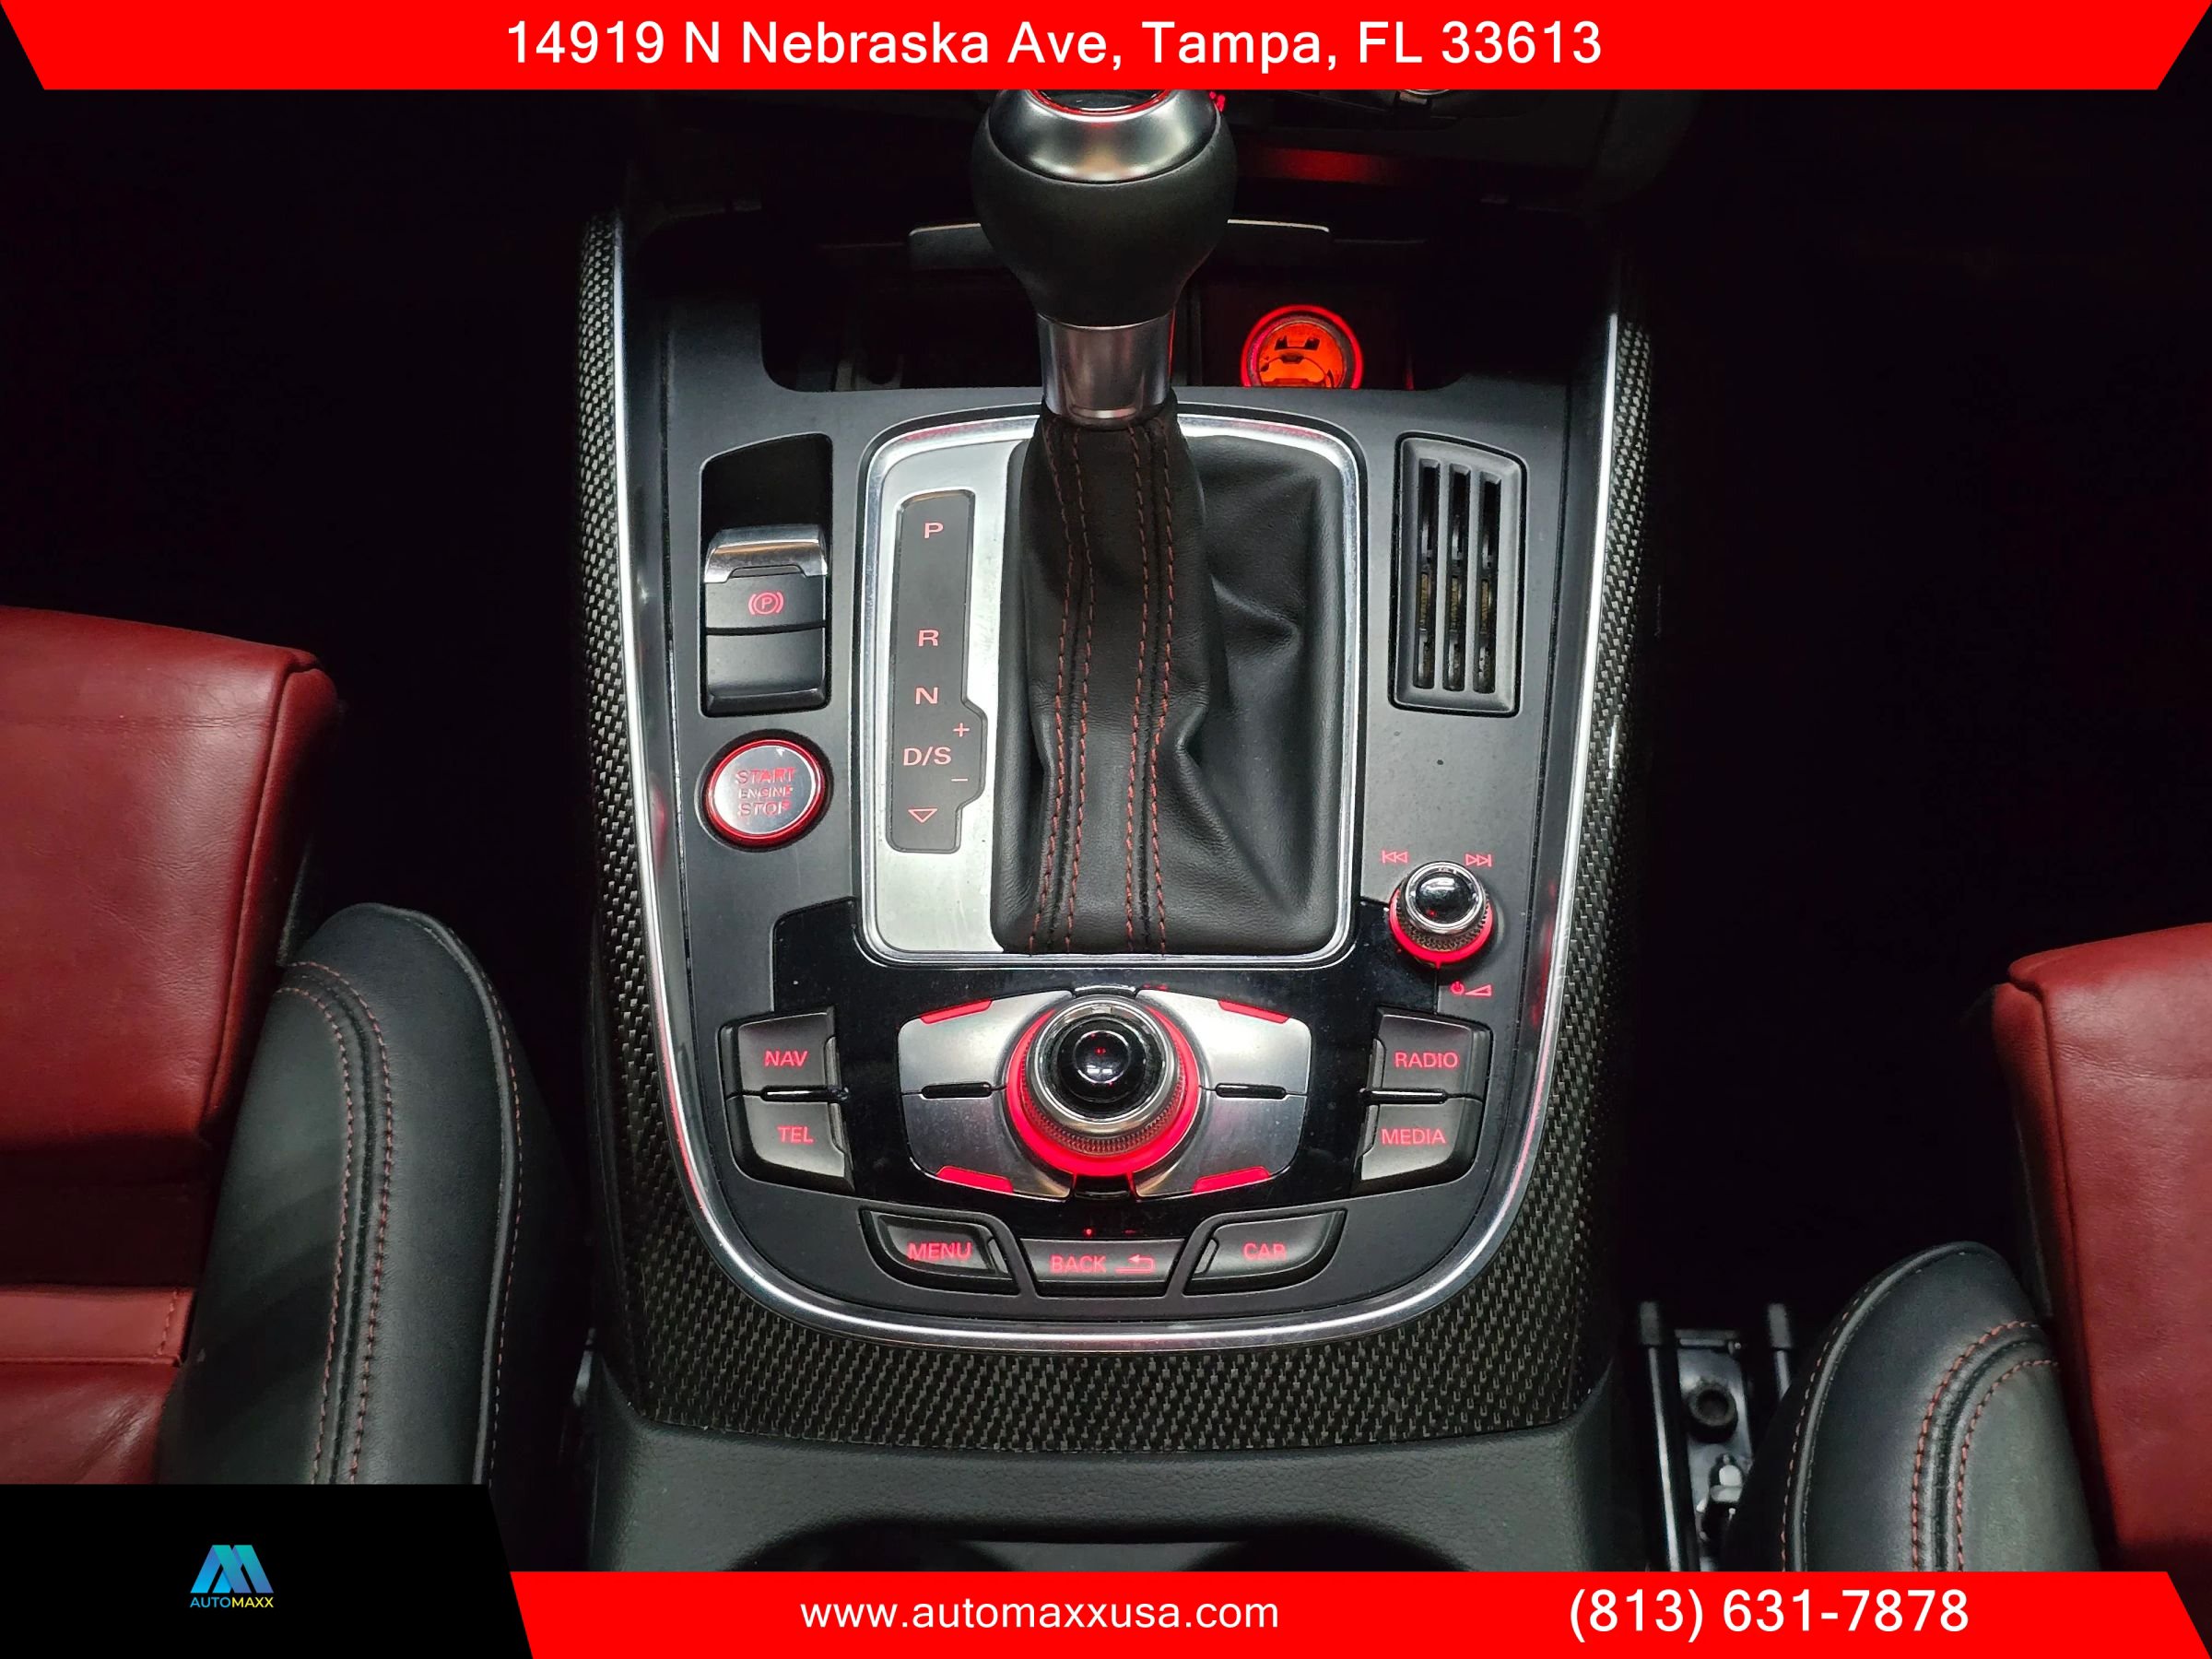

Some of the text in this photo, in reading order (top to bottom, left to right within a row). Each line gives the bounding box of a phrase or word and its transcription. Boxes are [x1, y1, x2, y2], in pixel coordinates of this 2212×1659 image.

[924, 523, 944, 539] P
[919, 629, 939, 647] R
[915, 688, 939, 704] N
[903, 746, 952, 767] D/S
[735, 767, 796, 785] START
[738, 785, 794, 799] ENGINE
[737, 799, 793, 817] STOP
[763, 1050, 808, 1068] NAV
[1394, 1052, 1459, 1069] RADIO
[777, 1125, 814, 1144] TEL
[1382, 1127, 1447, 1146] MEDIA
[907, 1241, 972, 1261] MENU
[1242, 1241, 1287, 1262] CAR
[1050, 1254, 1106, 1273] BACK
